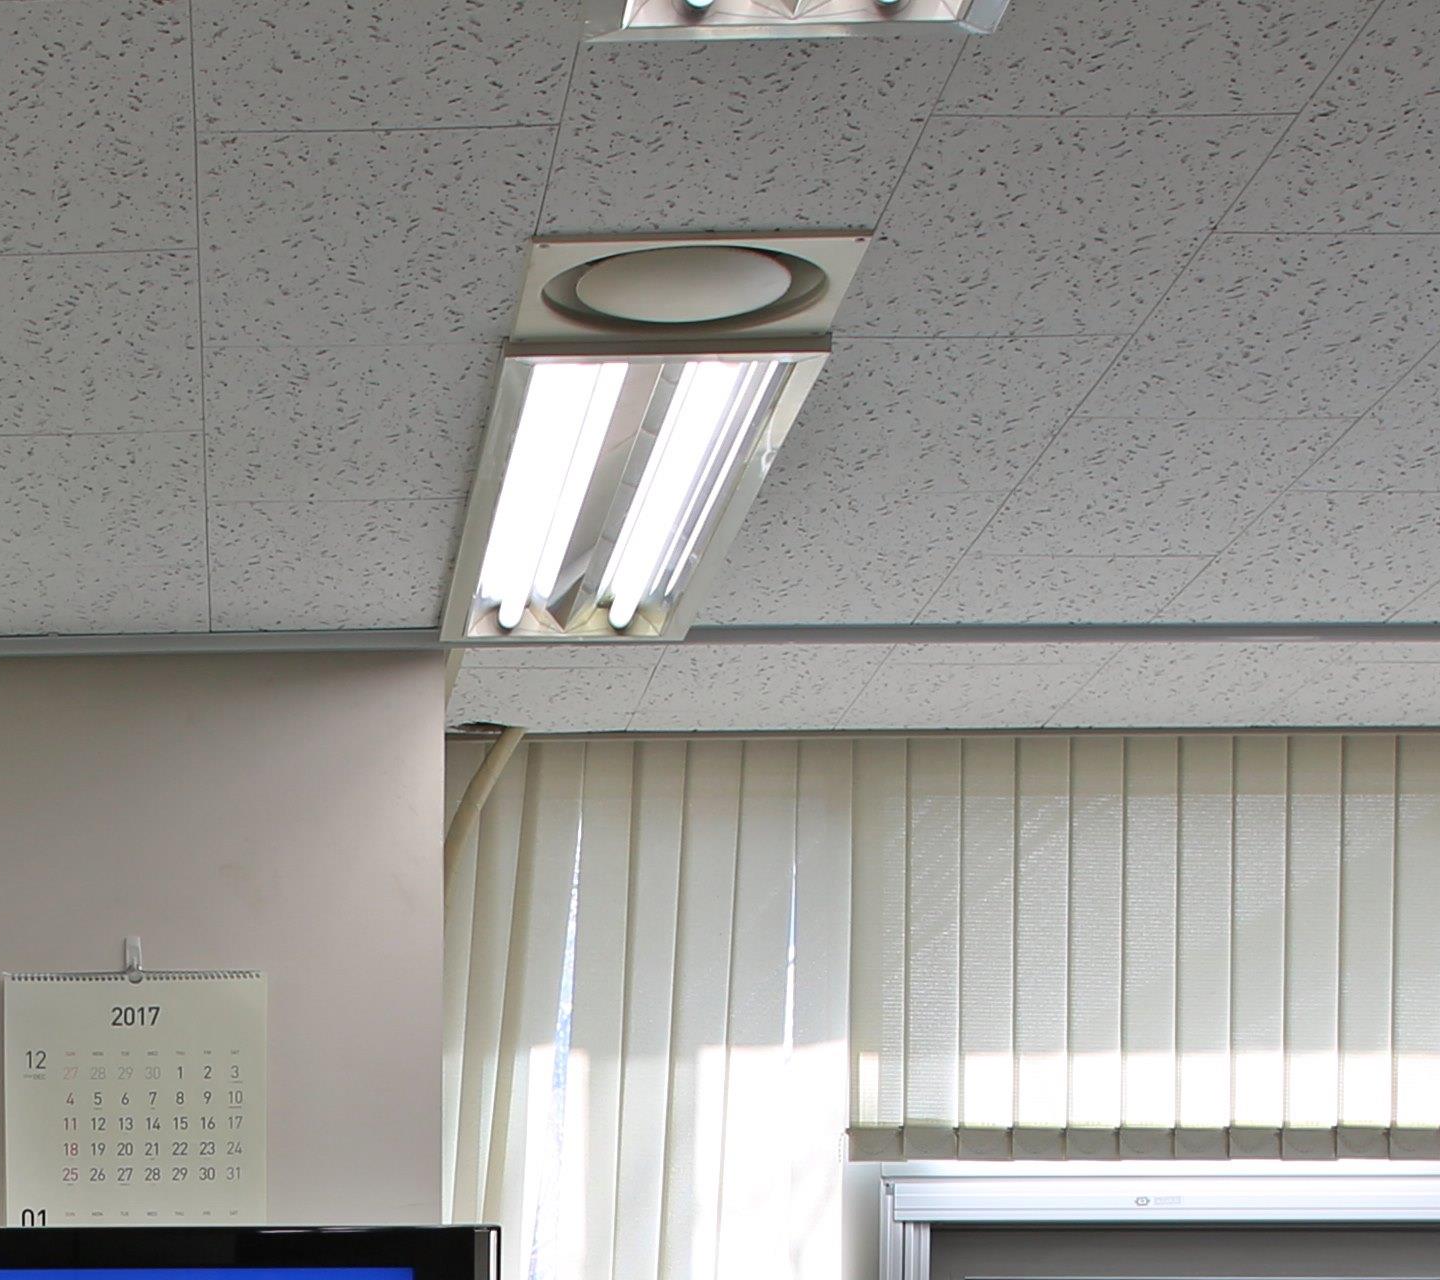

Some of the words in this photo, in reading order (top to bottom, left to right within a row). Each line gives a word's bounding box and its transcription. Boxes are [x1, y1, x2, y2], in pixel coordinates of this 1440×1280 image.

[111, 1006, 161, 1026] 2017
[25, 1051, 47, 1070] 12
[178, 1066, 182, 1079] 1
[204, 1066, 212, 1079] 2
[232, 1065, 239, 1078] 3
[66, 1093, 74, 1105] 4
[94, 1092, 102, 1105] 5
[121, 1093, 129, 1105] 6
[149, 1092, 157, 1105] 7
[176, 1091, 184, 1105] 8
[204, 1091, 211, 1104] 9
[229, 1090, 243, 1104] 10
[64, 1118, 76, 1130] 11
[91, 1117, 106, 1131] 12
[119, 1117, 133, 1131] 13
[146, 1117, 161, 1130] 14
[171, 1116, 188, 1130] 15
[201, 1117, 215, 1129] 16
[228, 1116, 243, 1129] 17
[64, 1143, 78, 1156] 18
[91, 1143, 105, 1156] 19
[117, 1142, 133, 1156] 20
[145, 1142, 158, 1156] 21
[172, 1142, 188, 1156] 22
[200, 1142, 215, 1155] 23
[227, 1142, 242, 1155] 24
[63, 1168, 78, 1181] 25
[89, 1168, 105, 1181] 26
[117, 1167, 133, 1181] 27
[144, 1167, 161, 1181] 28
[172, 1167, 188, 1181] 29
[199, 1167, 215, 1180] 30
[227, 1167, 240, 1180] 31
[22, 1209, 46, 1227] 01
